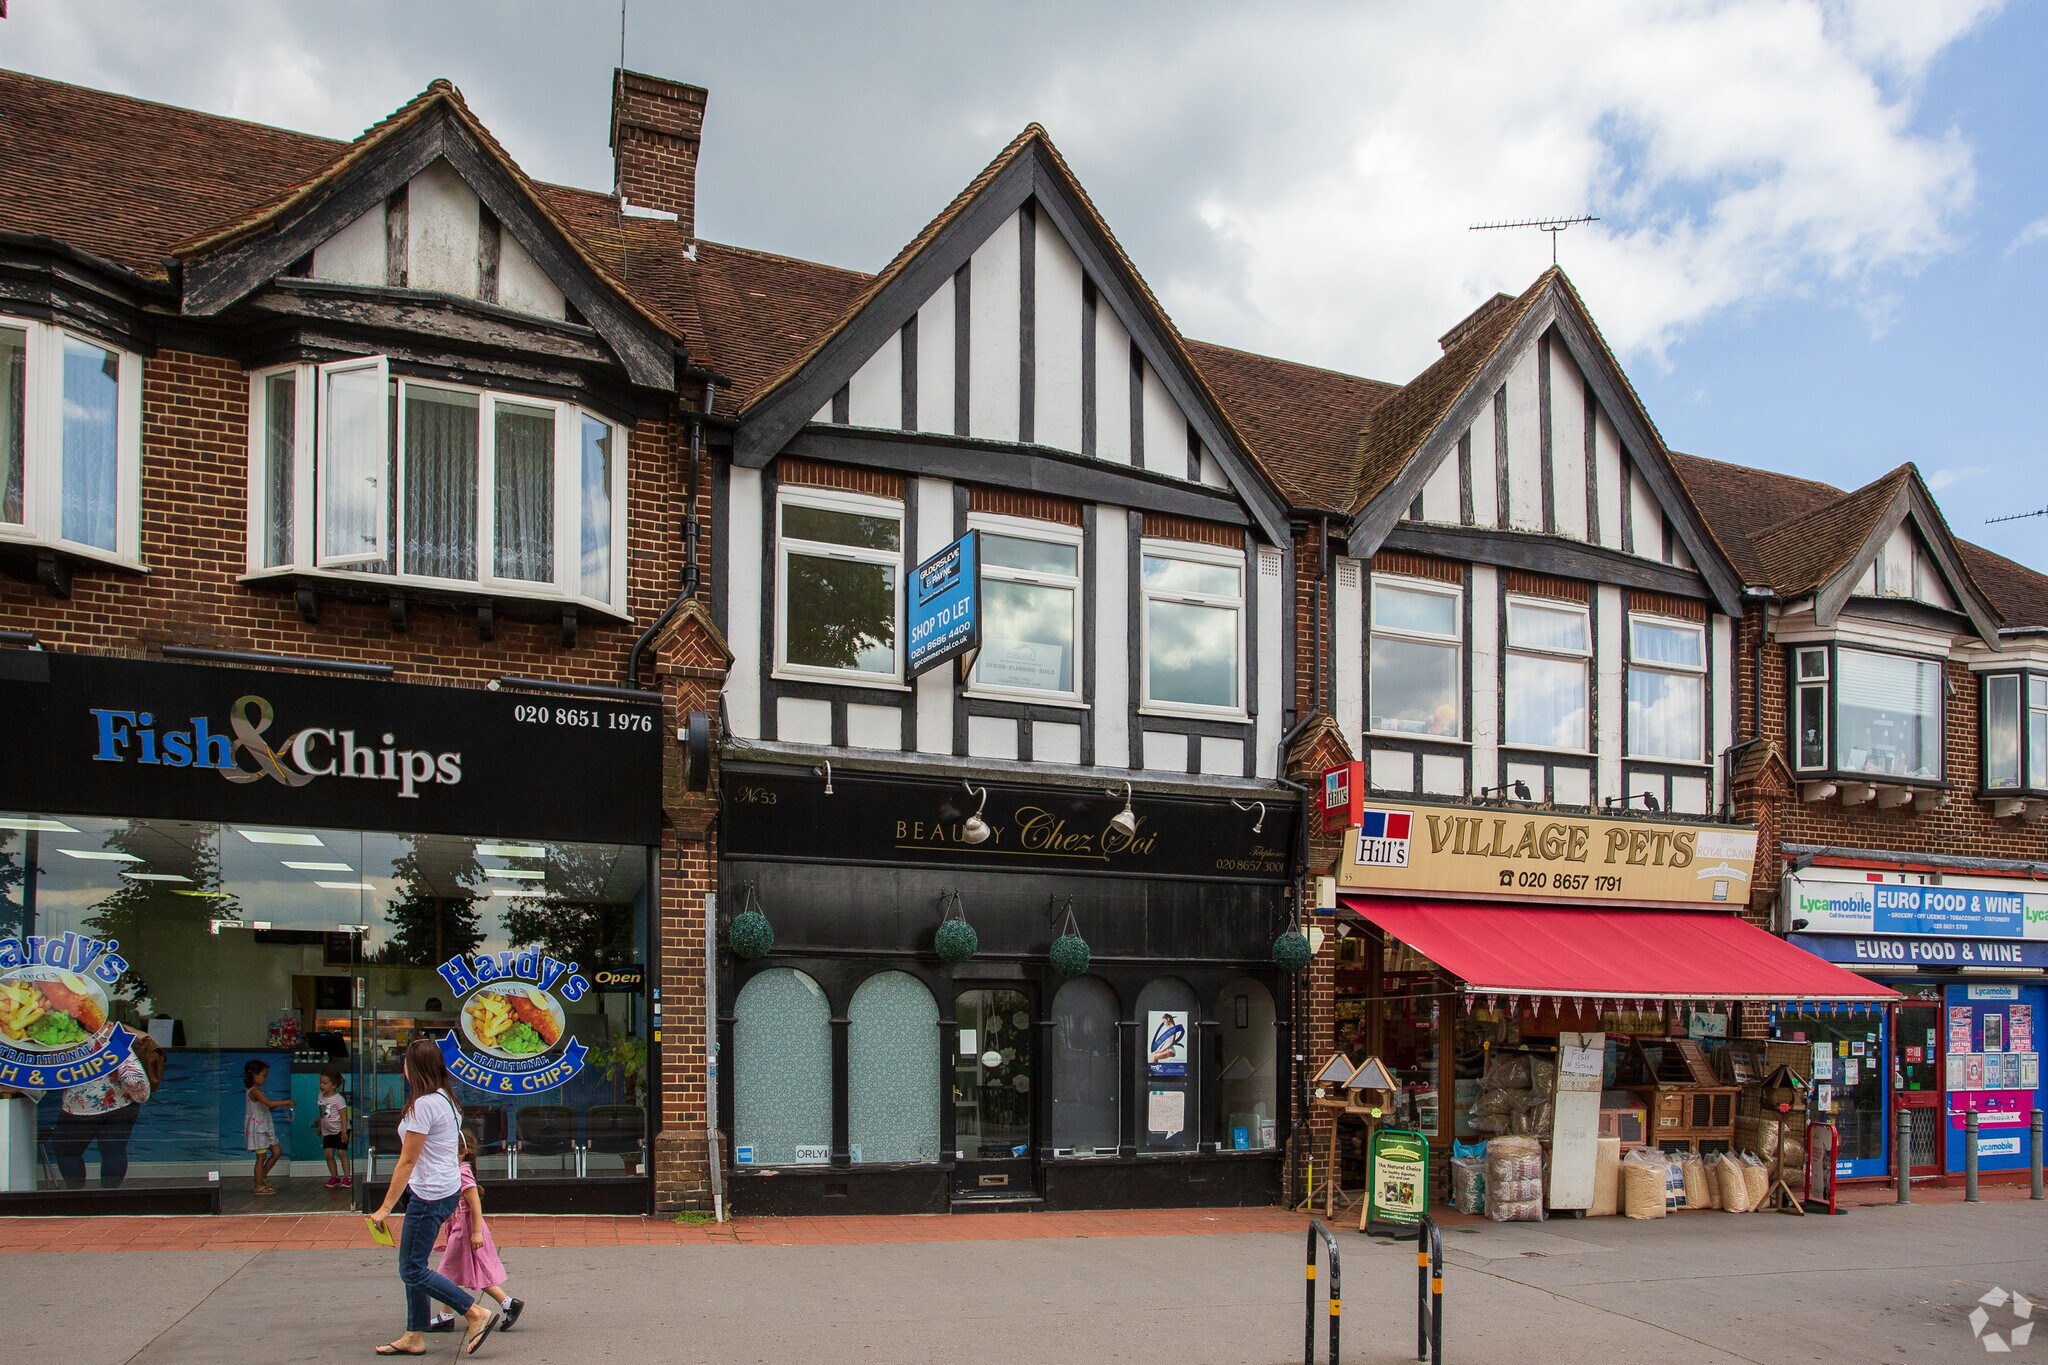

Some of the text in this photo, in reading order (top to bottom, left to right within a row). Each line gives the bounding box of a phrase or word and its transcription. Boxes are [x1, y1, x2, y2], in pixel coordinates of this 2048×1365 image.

[912, 596, 970, 644] SHOP TO LET
[911, 621, 970, 660] 020 8686 4400
[914, 635, 968, 670] gpcommercial.co.uk
[986, 662, 1006, 670] DESIGN
[1008, 664, 1036, 673] PLANNING
[514, 705, 652, 732] 020 8651 1976
[90, 694, 462, 798] Fish & Chips
[761, 792, 777, 804] 53
[1327, 789, 1348, 806] Hill's
[896, 820, 1005, 844] BEAUY
[1014, 806, 1095, 850] Chez
[1358, 839, 1405, 864] Hill's
[1426, 814, 1696, 869] VILLAGE PETS
[1698, 846, 1754, 859] ROYAL CANIN
[1216, 859, 1284, 872] 020 8657 3001
[1518, 872, 1622, 892] 020 8657 1791
[1800, 894, 1872, 913] Lycamobile
[1877, 891, 2022, 914] EURO FOOD & WINE
[1854, 940, 2022, 962] EURO FOOD & WINE
[437, 944, 590, 1002] Hardy's
[595, 970, 641, 985] Open
[1975, 986, 2012, 996] Lycamobile
[472, 1052, 550, 1072] TRADITIONAL
[1571, 1049, 1590, 1060] FISH
[28, 1069, 45, 1086] &
[56, 1049, 119, 1084] CHIPS
[450, 1056, 574, 1092] FISH & CHIPS
[797, 1150, 824, 1158] ORLY
[1978, 1142, 2013, 1152] Lycamobile
